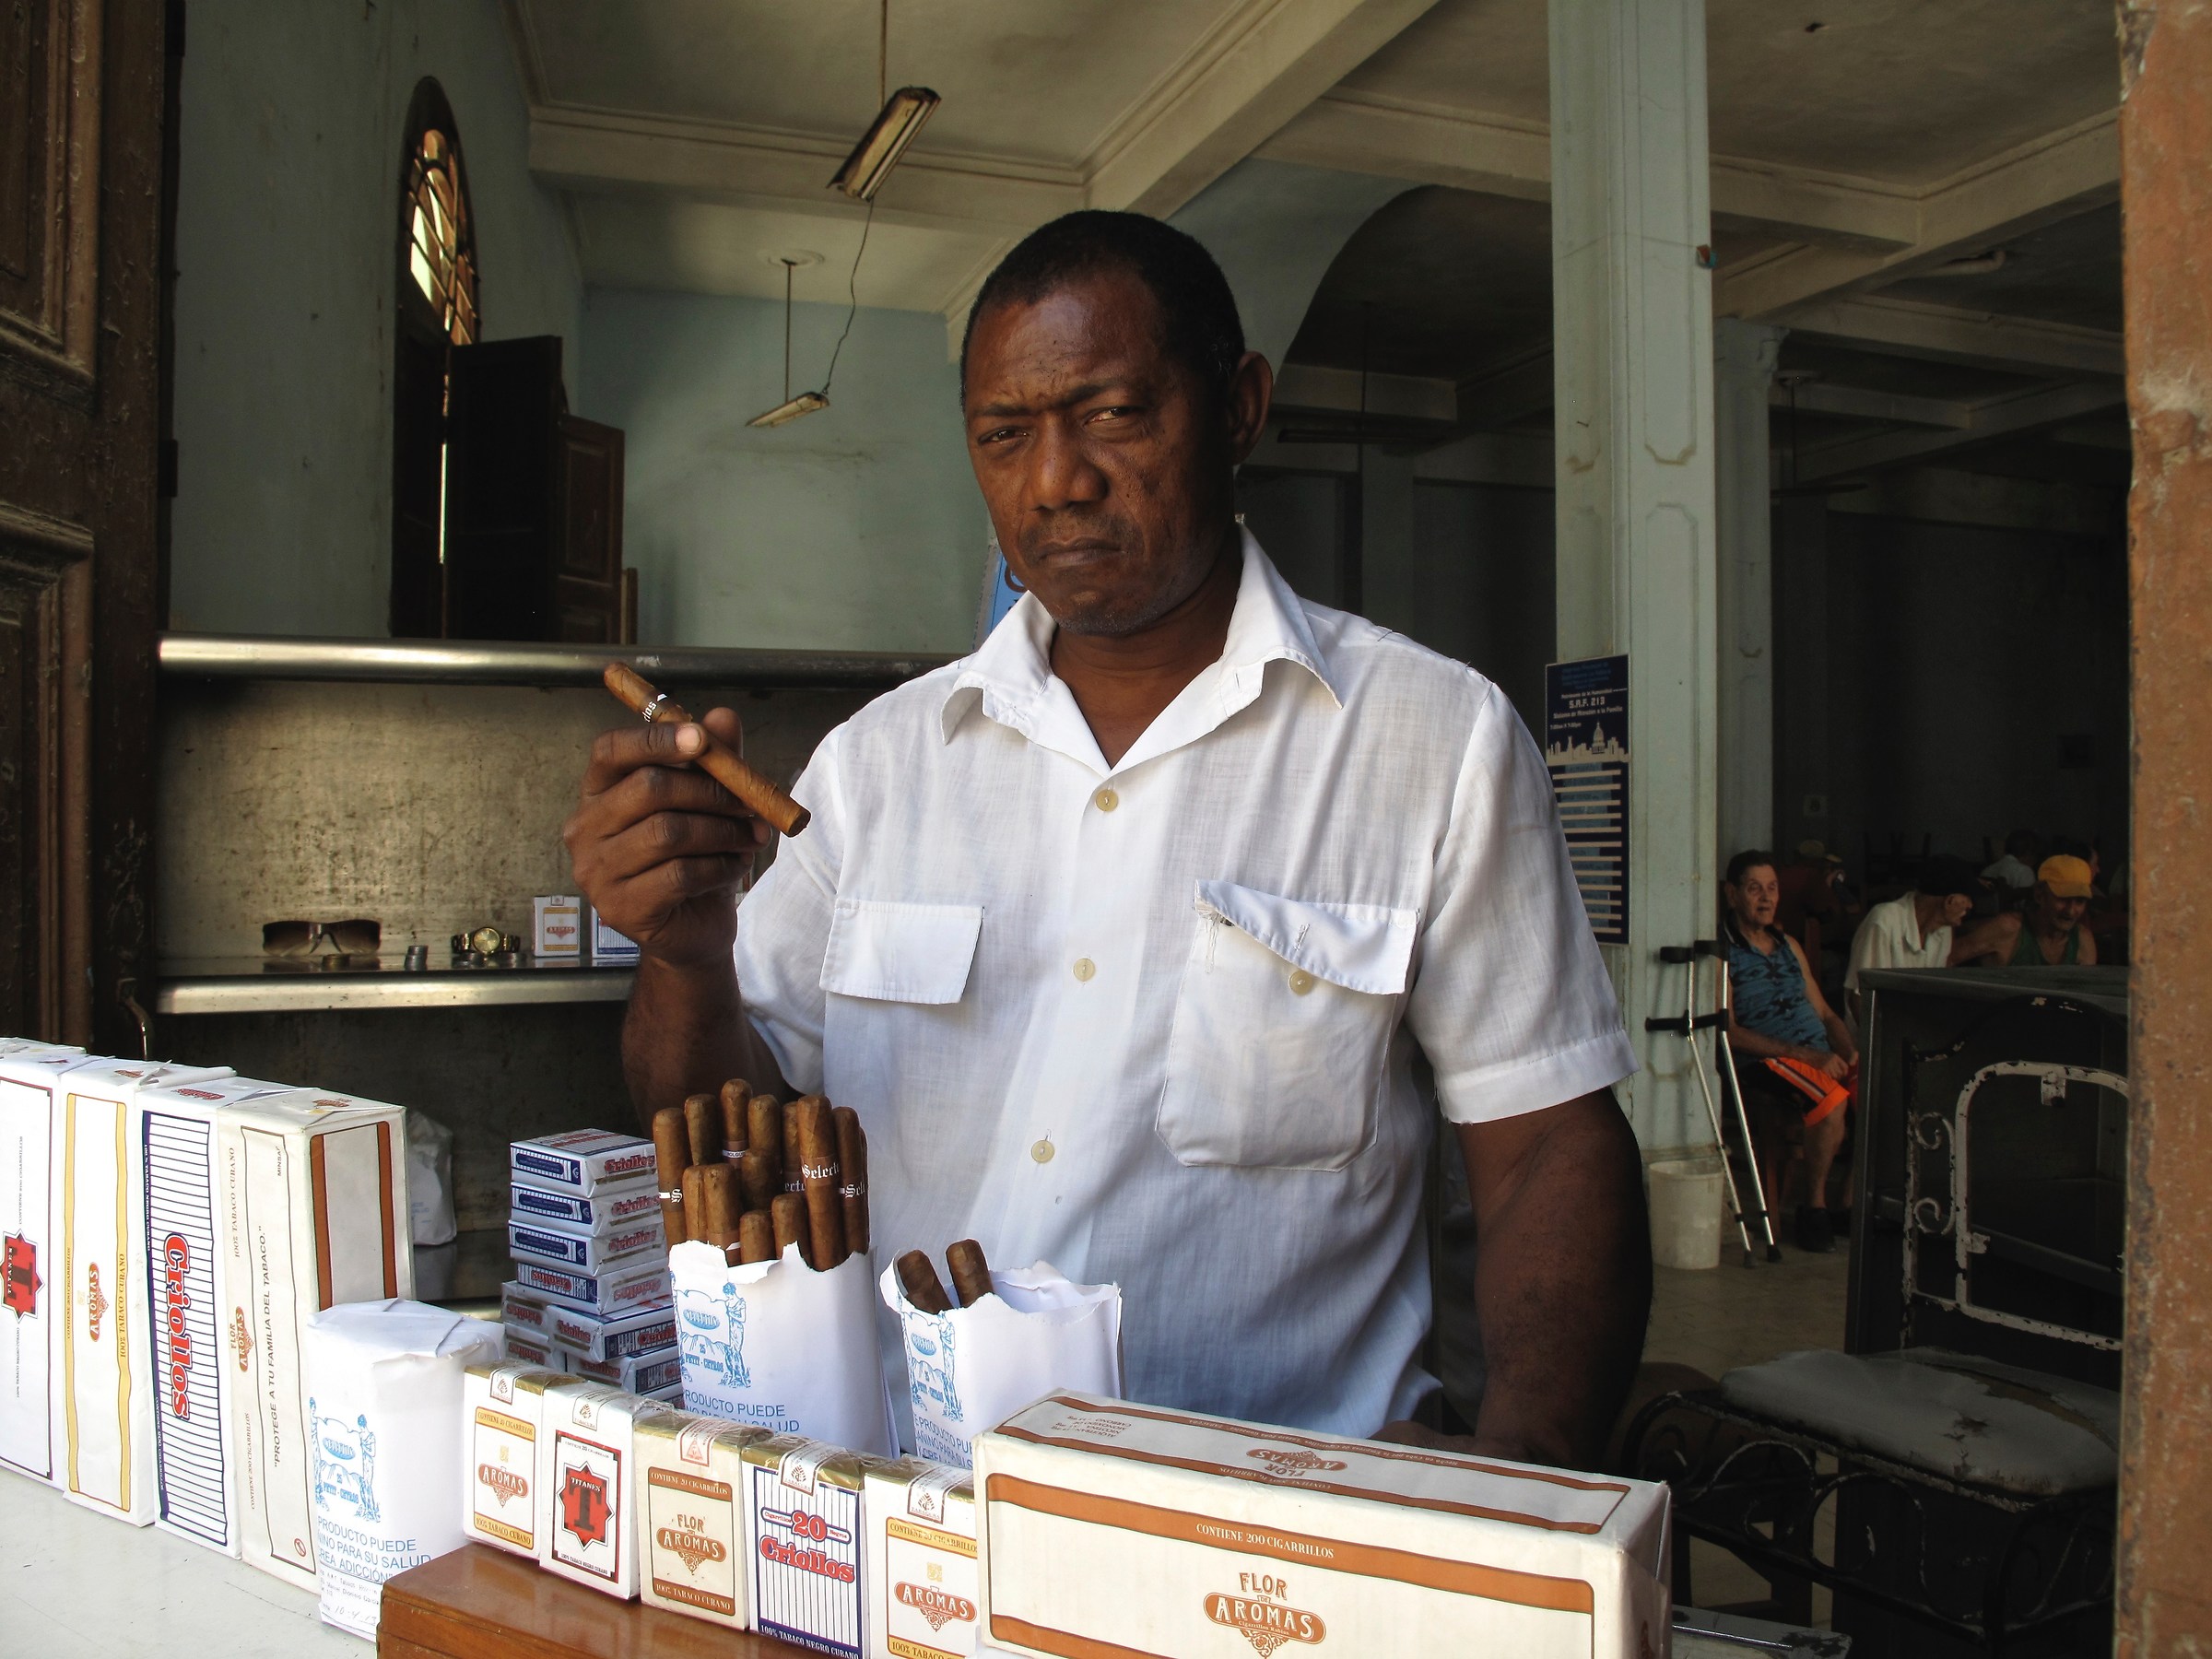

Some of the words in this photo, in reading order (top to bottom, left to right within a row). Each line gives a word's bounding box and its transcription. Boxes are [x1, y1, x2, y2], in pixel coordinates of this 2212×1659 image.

[604, 1154, 655, 1173] Criollos
[232, 1235, 241, 1259] 100%
[89, 1270, 100, 1335] AROMAS
[164, 1232, 193, 1420] Criollos
[229, 1322, 237, 1349] FLOR
[236, 1312, 248, 1366] AROMAS
[264, 1318, 275, 1368] FAMILIA
[267, 1370, 276, 1385] TU
[683, 1388, 735, 1414] RODUCTO
[737, 1403, 786, 1418] PUEDE
[477, 1411, 500, 1425] CONTIENE
[505, 1419, 534, 1436] CIGARRILLOS
[918, 1417, 956, 1447] PRODUCTO
[915, 1430, 939, 1450] AÑINO
[1254, 1450, 1339, 1469] AROMAS
[1265, 1463, 1306, 1477] FLOR
[482, 1467, 524, 1494] AROMAS
[570, 1476, 602, 1492] TITANES
[650, 1472, 680, 1487] CONTIENE
[688, 1479, 729, 1496] CIGARRILLOS
[317, 1515, 368, 1546] PRODUCTO
[370, 1536, 417, 1553] PUEDE
[487, 1522, 509, 1536] TABACO
[509, 1527, 531, 1545] CUBANO
[677, 1513, 705, 1532] FLOR
[791, 1509, 829, 1542] 20
[829, 1528, 849, 1540] Negros
[889, 1522, 923, 1537] CONTIENE
[337, 1541, 362, 1560] PARA
[364, 1550, 379, 1566] SU
[663, 1530, 720, 1559] AROMAS
[1195, 1523, 1244, 1543] CONTIENE
[1246, 1532, 1266, 1547] 200
[1266, 1535, 1335, 1559] CIGARRILLOS
[759, 1534, 856, 1584] Criollos
[655, 1583, 672, 1595] 100%
[672, 1588, 700, 1604] TABACO
[700, 1595, 732, 1611] CUBANO
[1239, 1571, 1288, 1600] FLOR
[902, 1584, 969, 1618] AROMAS
[1215, 1596, 1314, 1640] AROMAS
[760, 1624, 778, 1637] 100%
[778, 1630, 805, 1645] TABACO
[805, 1639, 830, 1653] NEGRO
[830, 1646, 859, 1659] CUBANO
[891, 1641, 911, 1654] 100%
